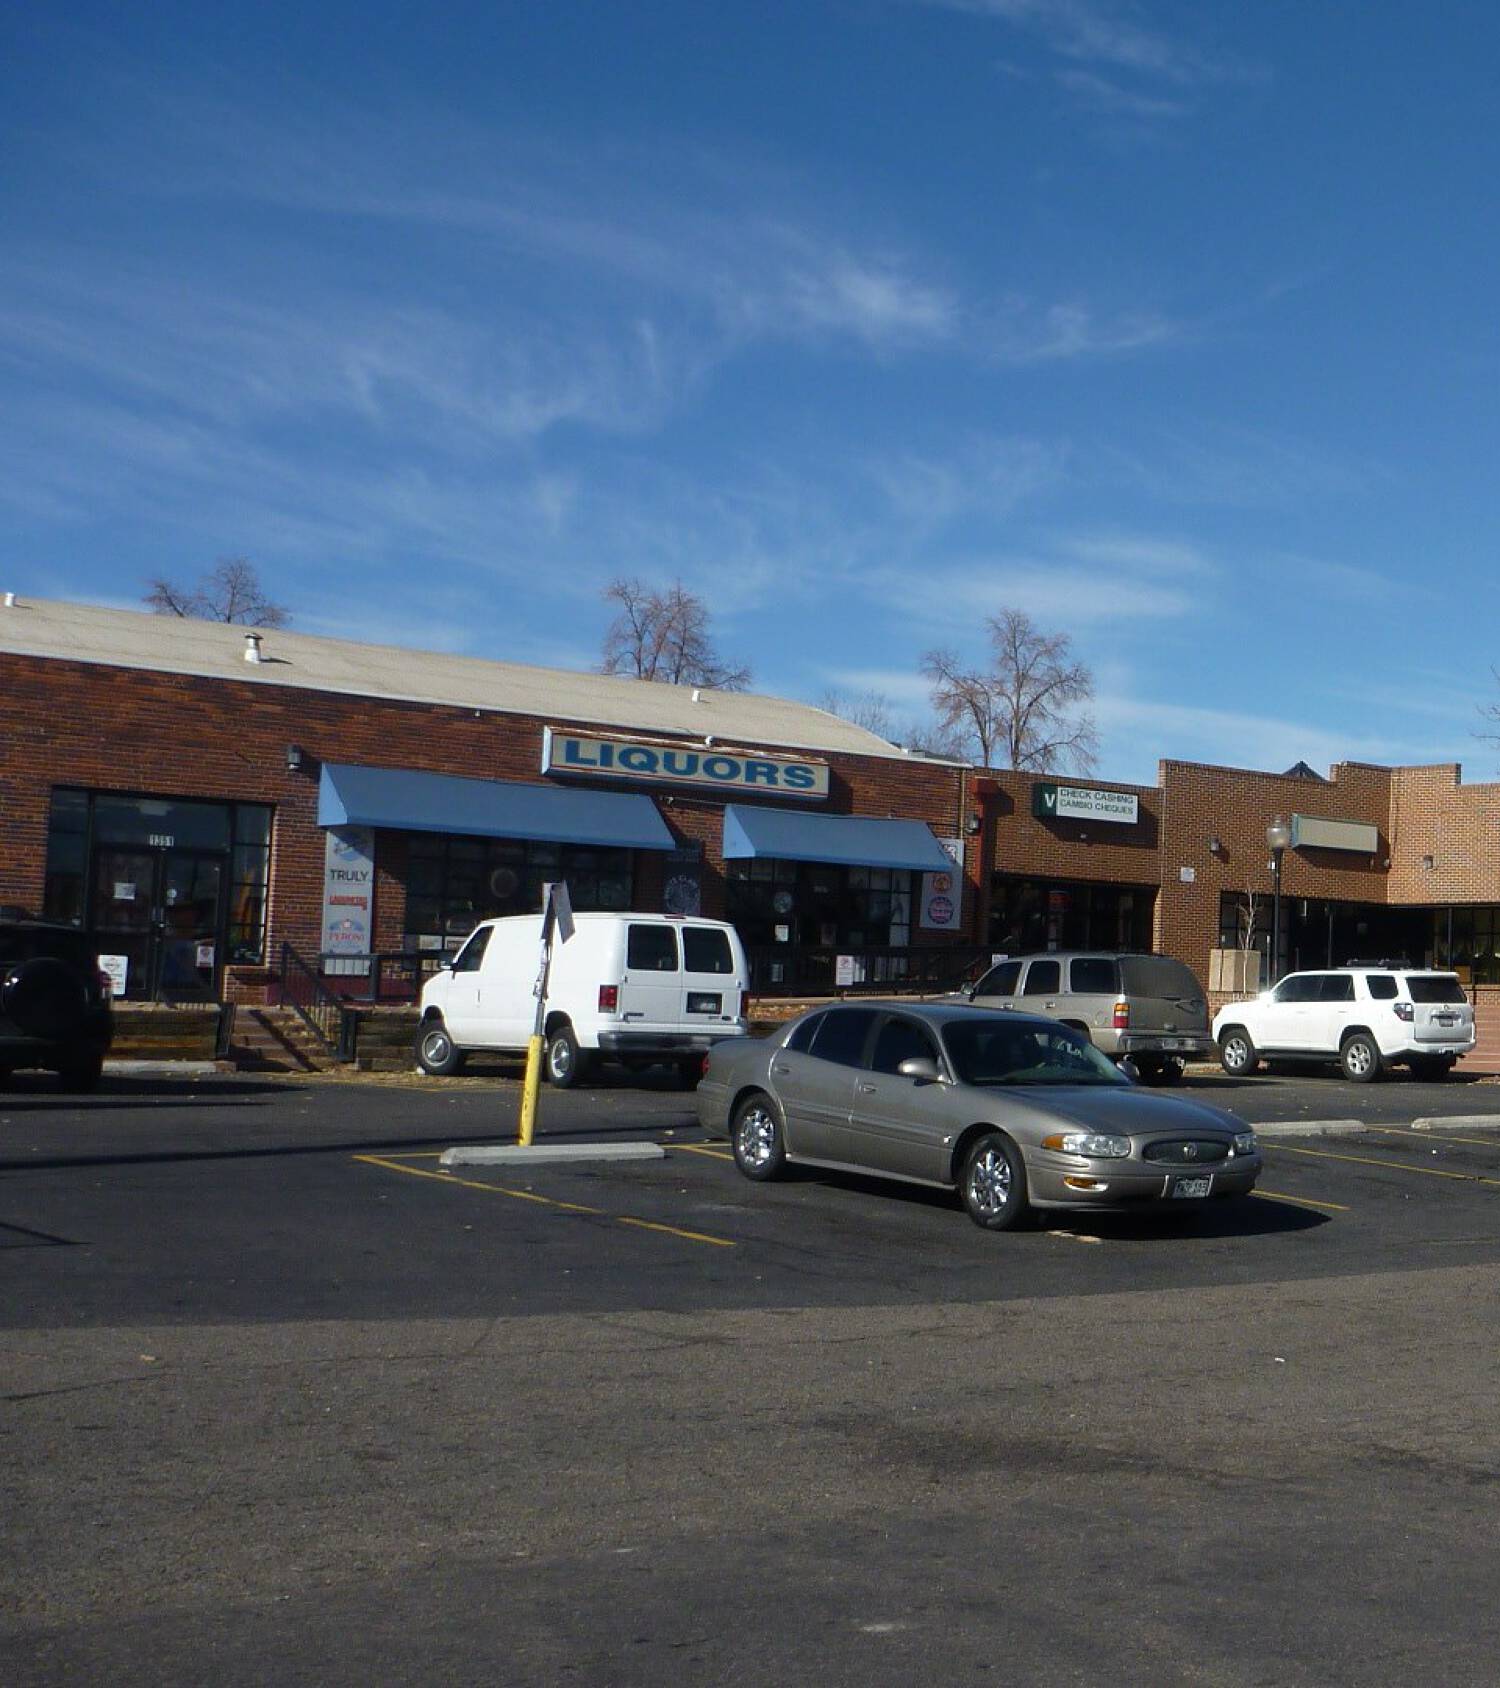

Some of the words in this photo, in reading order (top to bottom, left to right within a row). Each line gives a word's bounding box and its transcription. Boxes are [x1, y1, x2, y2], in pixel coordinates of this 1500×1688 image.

[565, 740, 815, 788] LIQUORS
[1044, 793, 1056, 808] V
[1060, 788, 1091, 799] CHECK
[1094, 791, 1134, 804] CASHING
[1094, 802, 1134, 815] CHEQUES
[330, 869, 369, 881] TRULY
